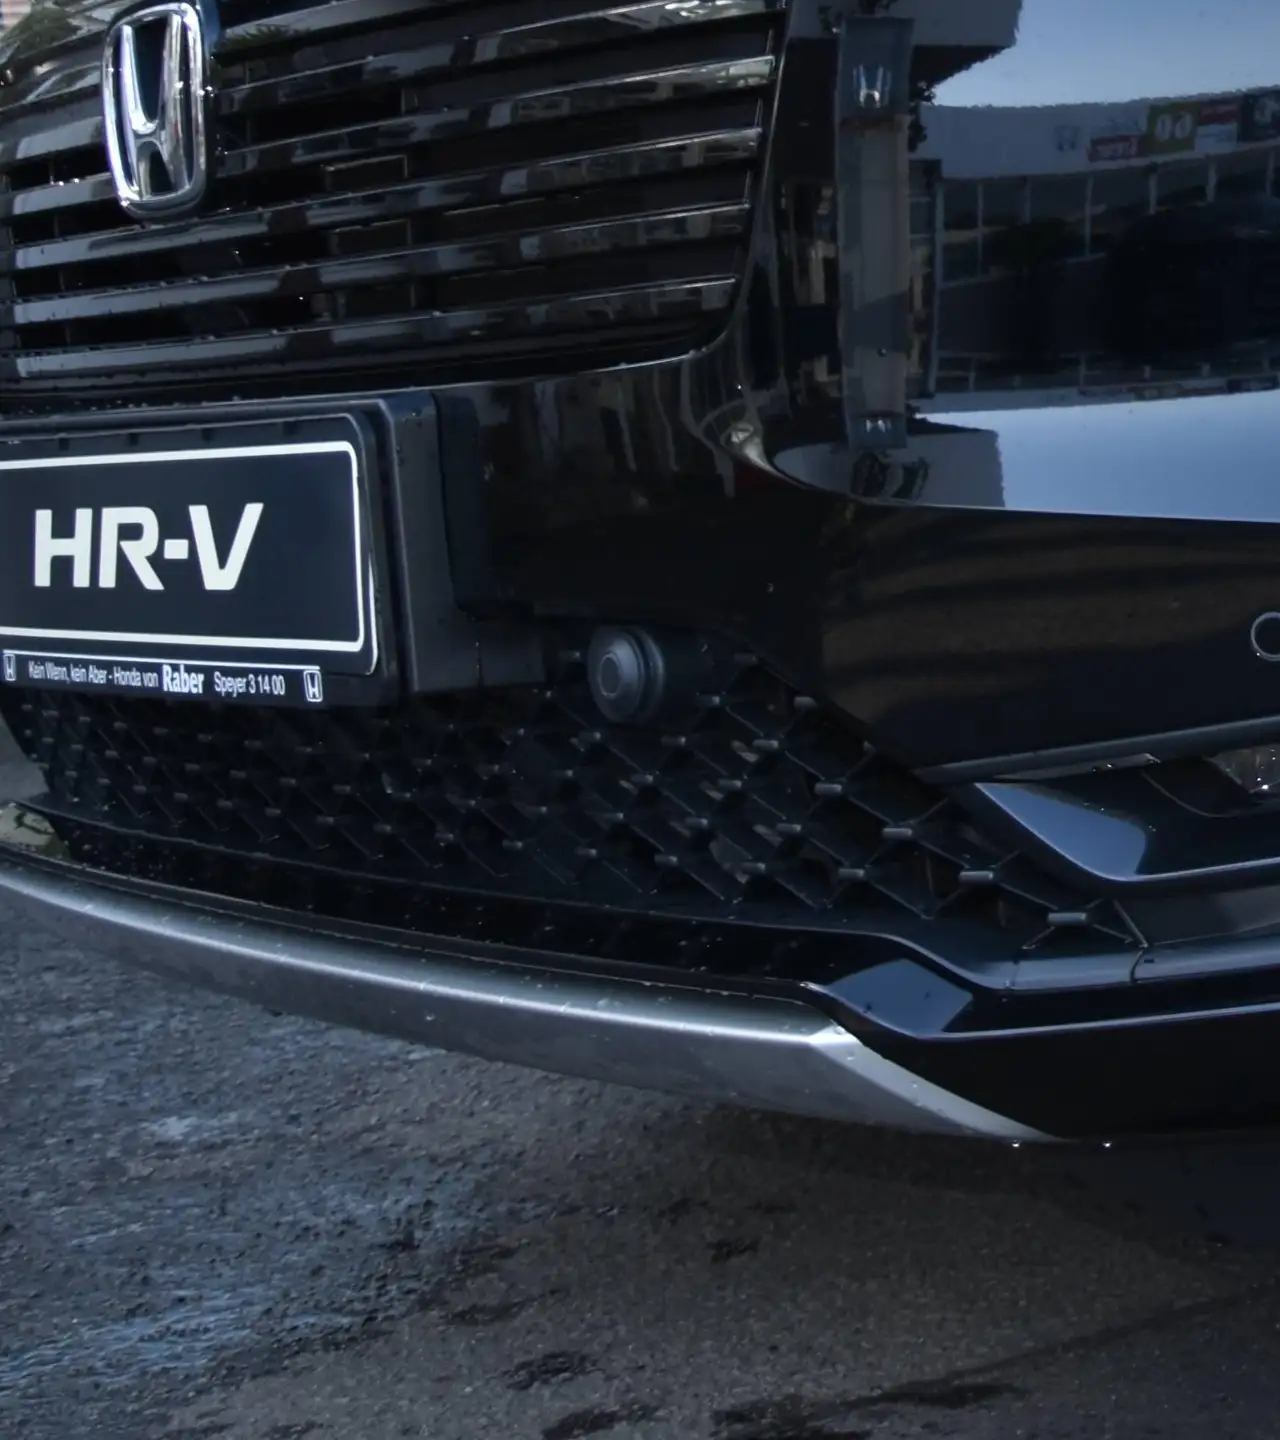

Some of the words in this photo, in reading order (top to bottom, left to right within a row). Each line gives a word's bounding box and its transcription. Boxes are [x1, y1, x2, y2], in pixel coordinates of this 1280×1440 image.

[34, 502, 264, 591] HR-V
[88, 664, 107, 684] Aber
[113, 665, 142, 686] Honda
[142, 671, 159, 687] von
[162, 663, 205, 694] Raber
[213, 671, 248, 697] Speyer
[248, 673, 256, 694] 3
[258, 674, 270, 694] 14
